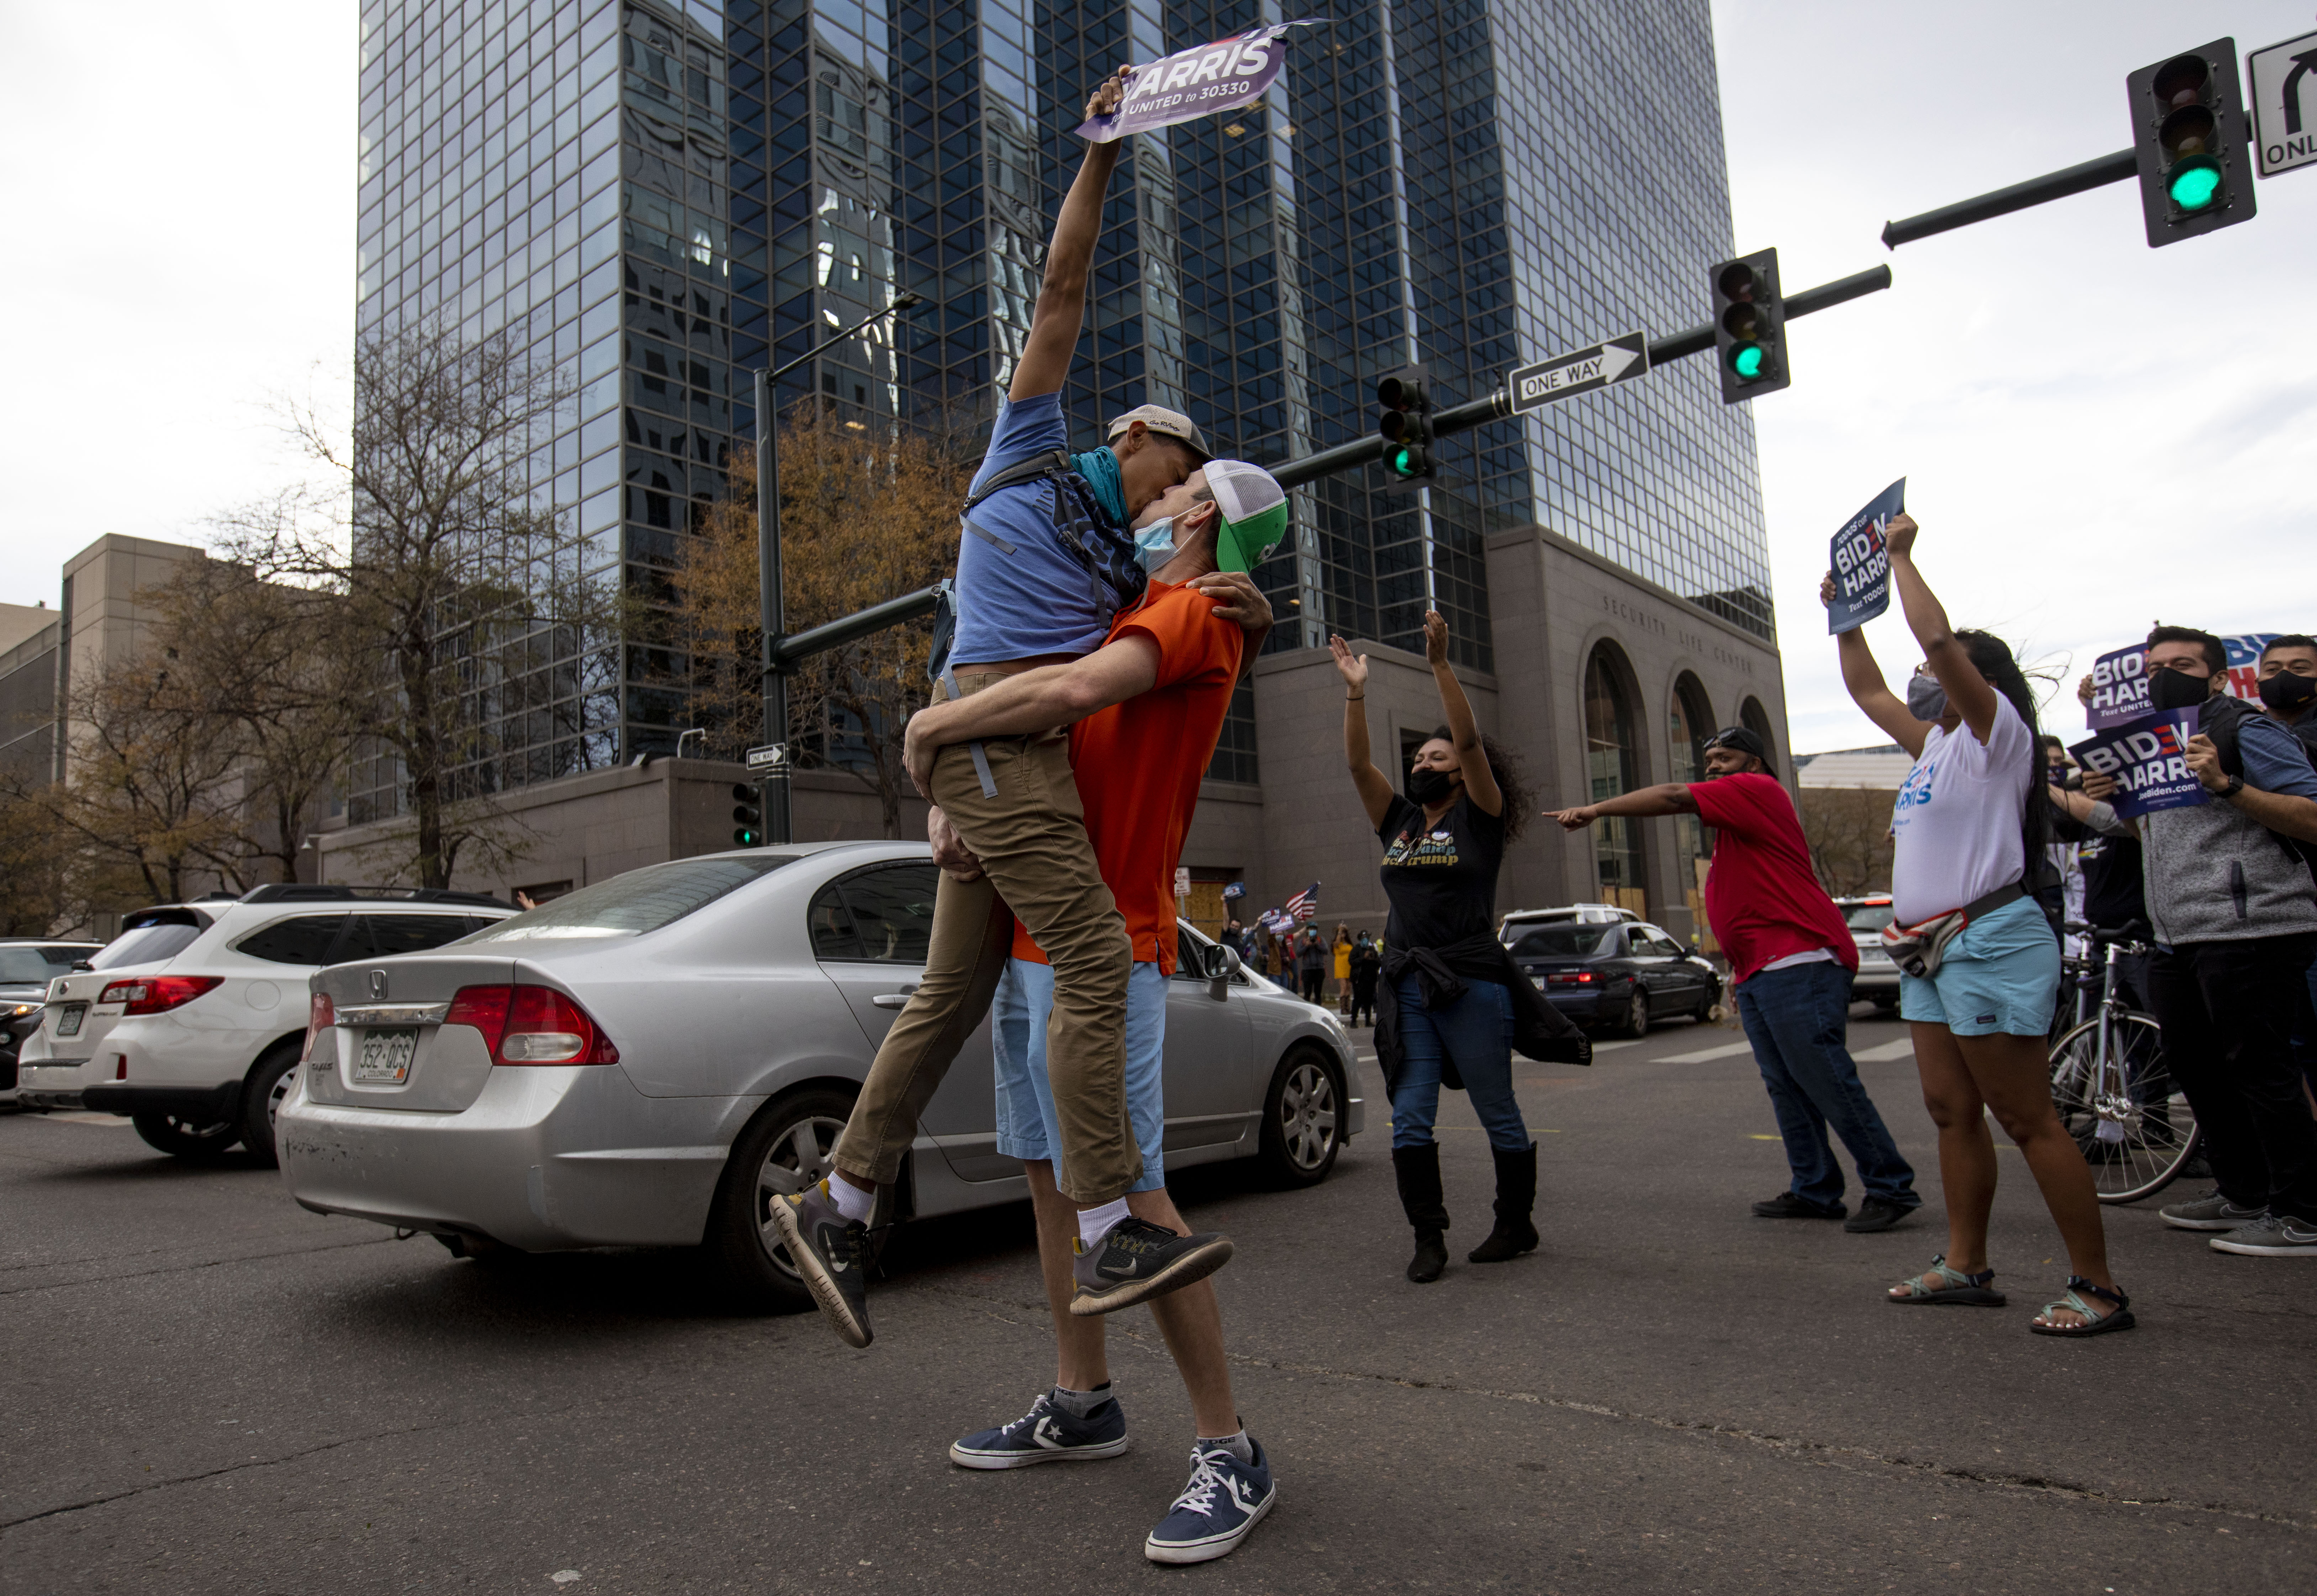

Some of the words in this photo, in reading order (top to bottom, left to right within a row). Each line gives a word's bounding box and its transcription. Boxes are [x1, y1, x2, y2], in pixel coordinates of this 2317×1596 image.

[1110, 109, 1127, 125] Text
[1129, 94, 1182, 115] UNITED
[1185, 93, 1196, 103] to
[1199, 81, 1250, 99] 30330
[1526, 372, 1560, 395] ONE
[1567, 358, 1602, 383] WAY
[1836, 512, 1886, 575] BIDEN
[1848, 600, 1863, 612] Text
[1862, 583, 1885, 604] TODOS
[1604, 596, 1665, 636] SECURITY
[1679, 629, 1702, 652] LIFE
[1714, 646, 1751, 673] CENTER
[2100, 708, 2118, 717] Text
[763, 752, 773, 760] WAY
[2082, 721, 2189, 774] BIDEN
[2138, 783, 2196, 801] JoeBiden.com
[1407, 855, 1459, 866] trump
[1198, 1436, 1235, 1445] EDGE
